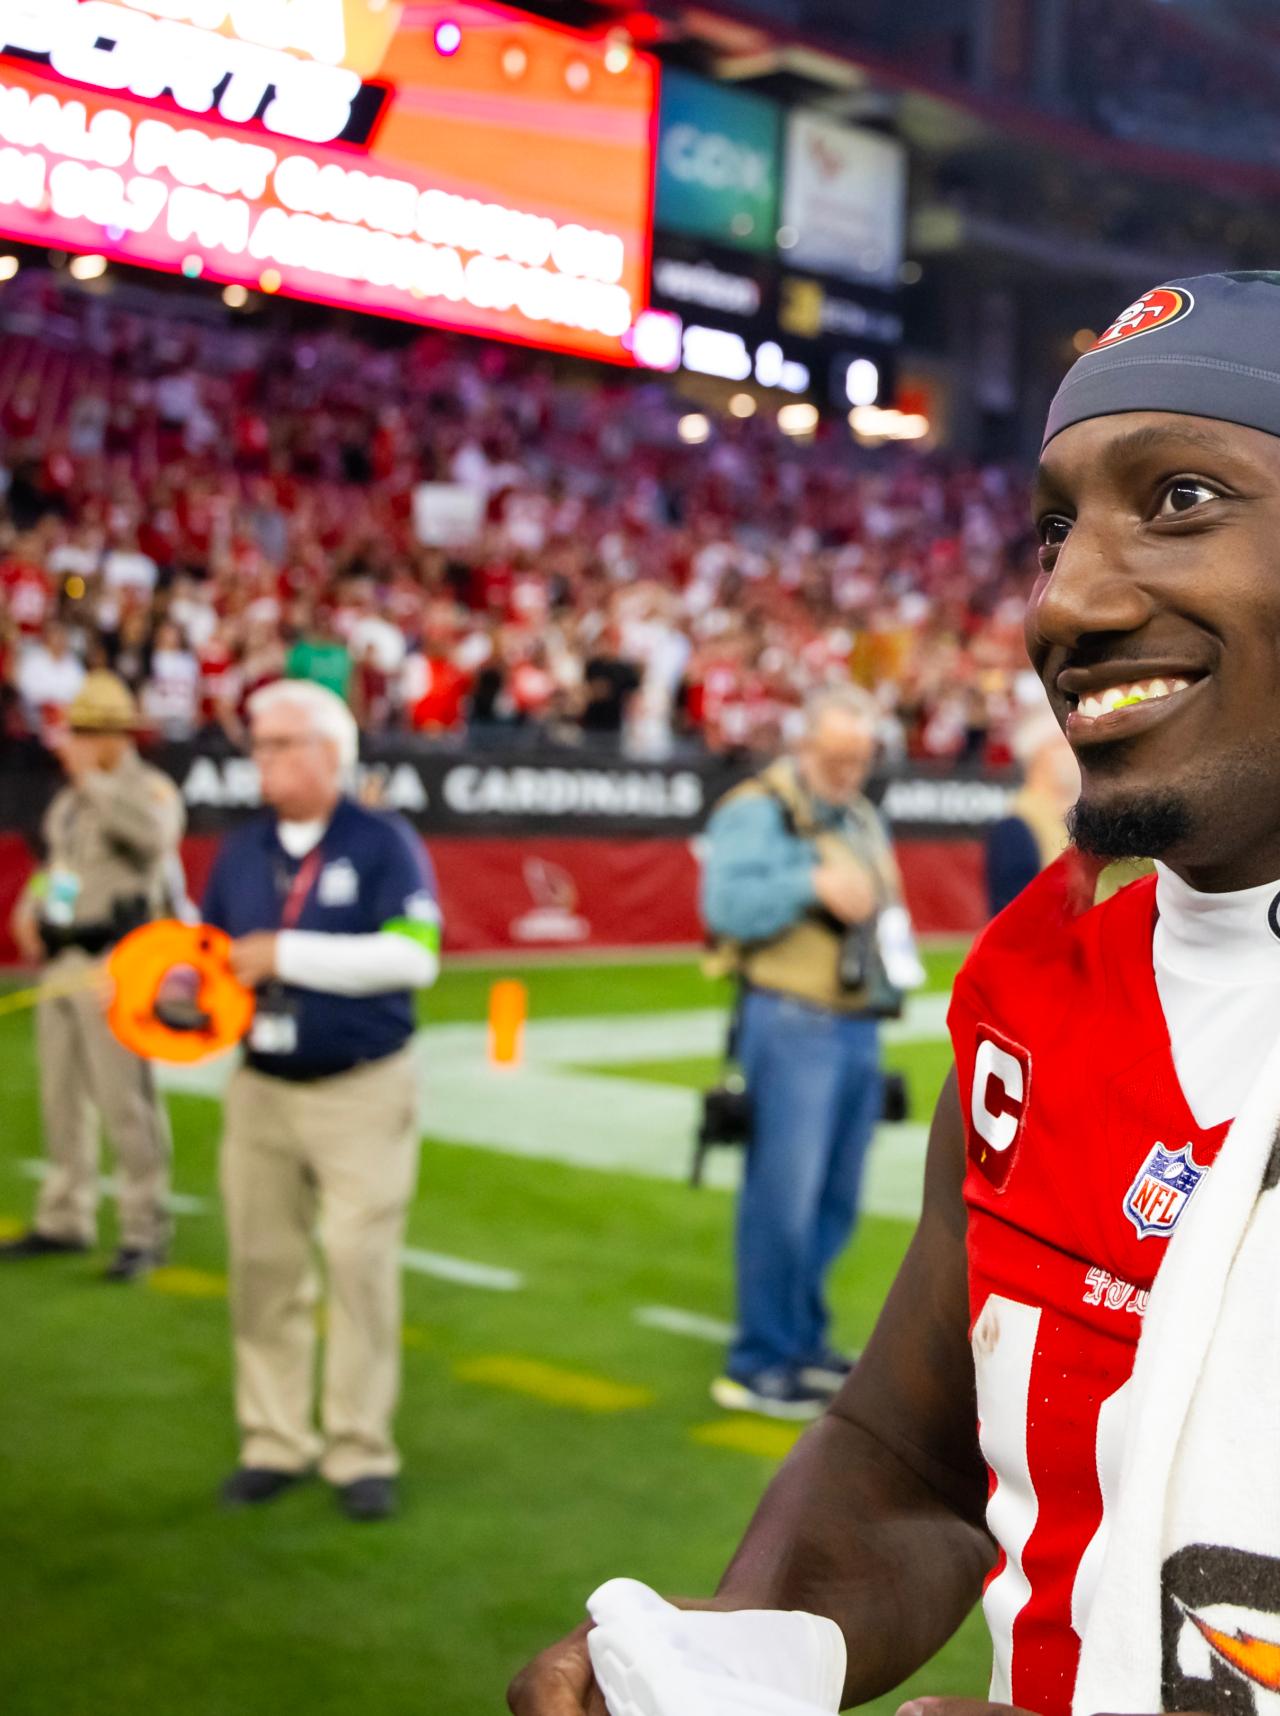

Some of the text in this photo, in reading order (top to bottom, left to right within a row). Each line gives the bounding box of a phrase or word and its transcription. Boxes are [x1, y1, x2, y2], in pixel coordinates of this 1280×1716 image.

[443, 765, 702, 817] CARDINALS
[971, 1039, 1024, 1152] C
[1132, 1178, 1178, 1224] NFL
